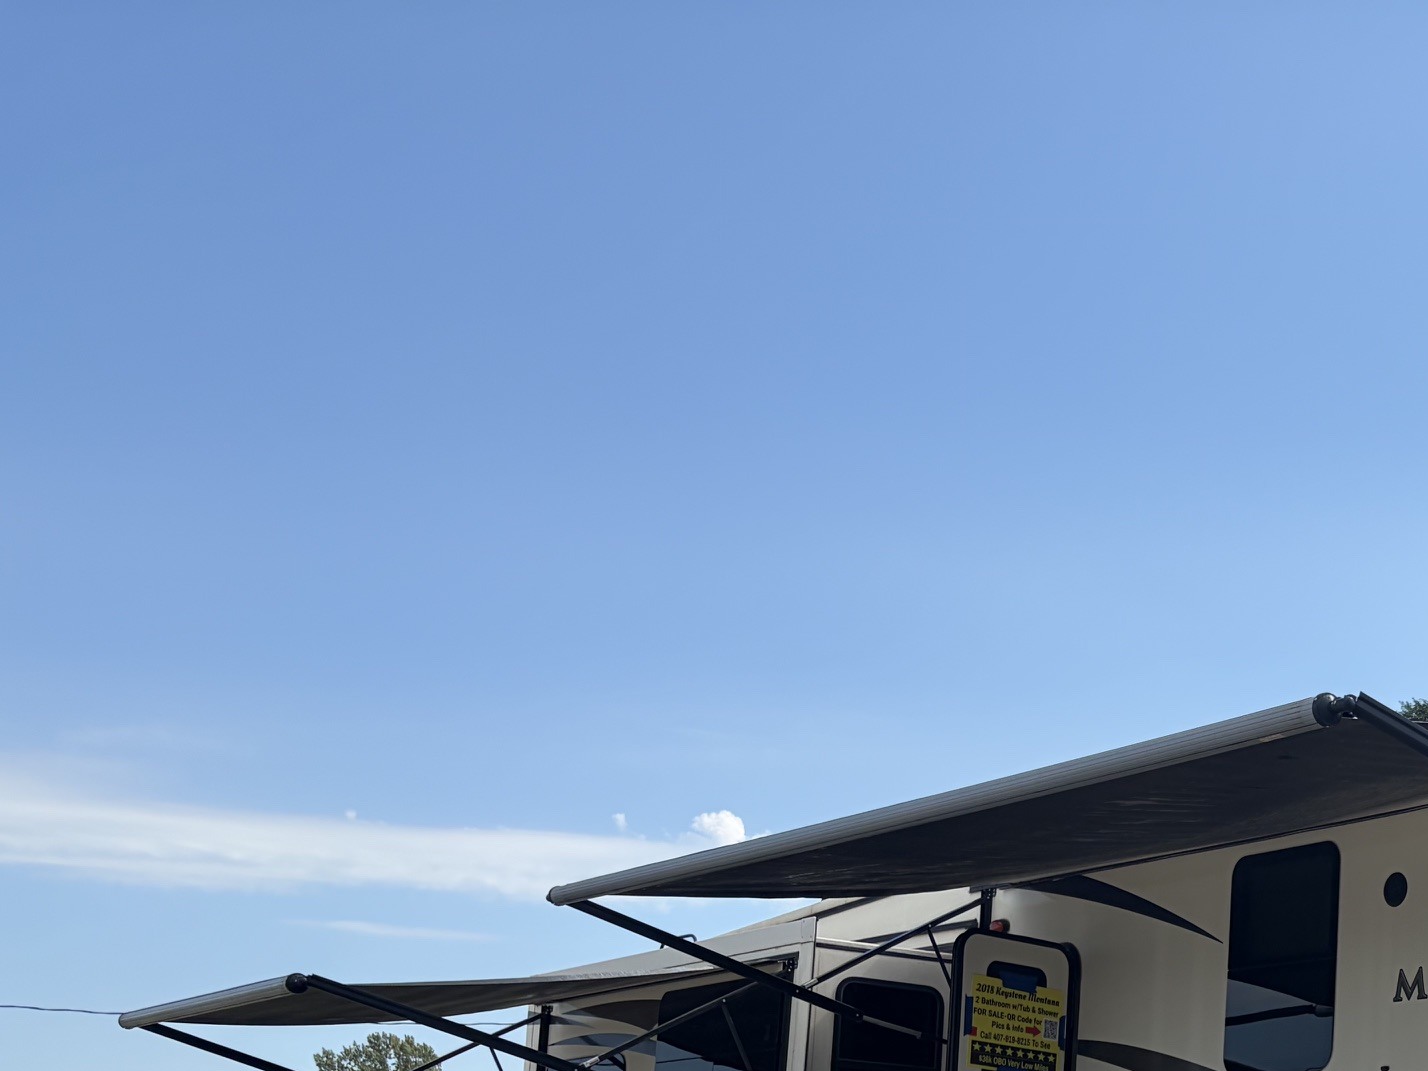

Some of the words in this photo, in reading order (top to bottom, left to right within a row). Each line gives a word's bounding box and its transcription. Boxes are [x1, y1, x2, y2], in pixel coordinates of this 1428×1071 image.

[976, 983, 995, 995] 2018
[995, 986, 1027, 999] Keystone
[1028, 992, 1060, 1007] Montana
[973, 1006, 987, 1016] FOR
[988, 1009, 1016, 1021] SALE-QR
[1017, 1015, 1033, 1024] Code
[1033, 1018, 1042, 1027] for
[981, 997, 1011, 1009] Bathroom
[1012, 1003, 1031, 1013] w/Tub
[1031, 1006, 1036, 1014] &
[1037, 1007, 1060, 1018] Shower
[991, 1021, 1005, 1030] Pics
[1006, 1023, 1011, 1031] &
[1012, 1024, 1024, 1033] Info
[980, 1030, 992, 1040] Call
[1032, 1039, 1040, 1048] To
[1040, 1041, 1051, 1050] See
[1007, 1058, 1020, 1069] Very
[1021, 1060, 1034, 1070] Low
